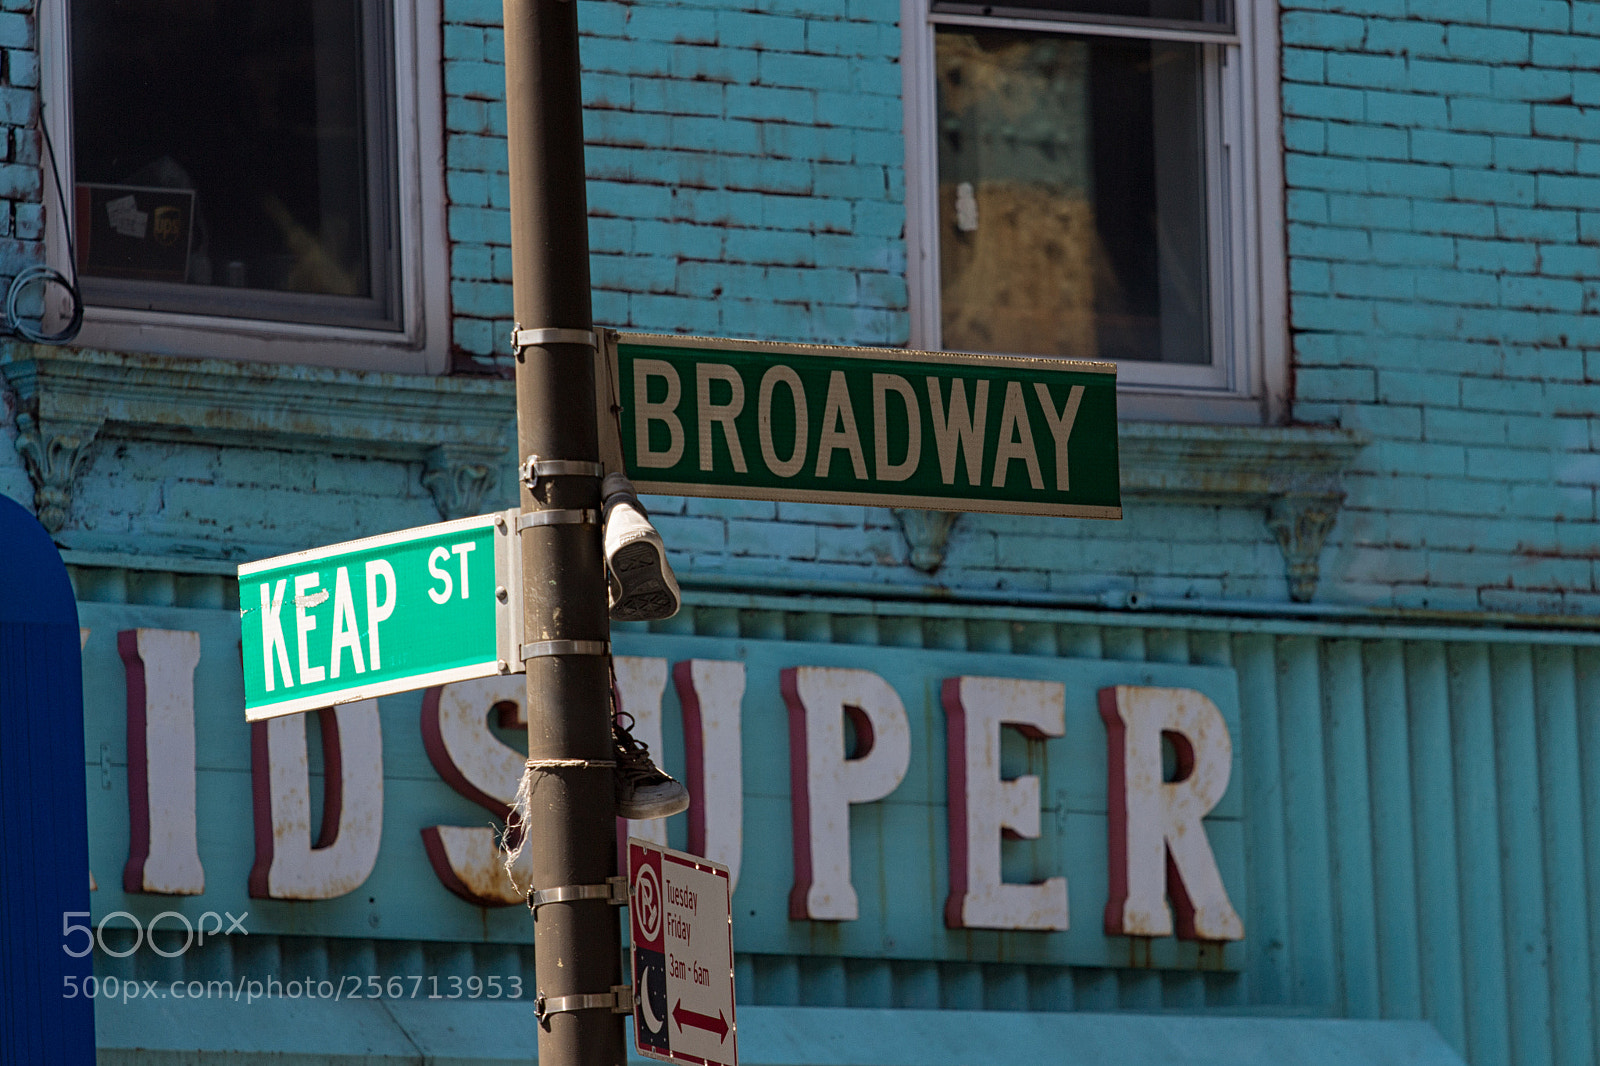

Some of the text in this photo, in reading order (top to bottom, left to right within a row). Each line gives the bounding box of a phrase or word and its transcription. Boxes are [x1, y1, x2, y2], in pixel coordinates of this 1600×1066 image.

[633, 358, 1086, 492] BROADWAY
[260, 541, 476, 692] KEAP ST
[80, 626, 1244, 942] IDSUPER
[666, 879, 698, 916] Tuesday
[667, 912, 691, 947] Friday
[669, 953, 686, 980] 3am
[693, 960, 710, 987] 6am
